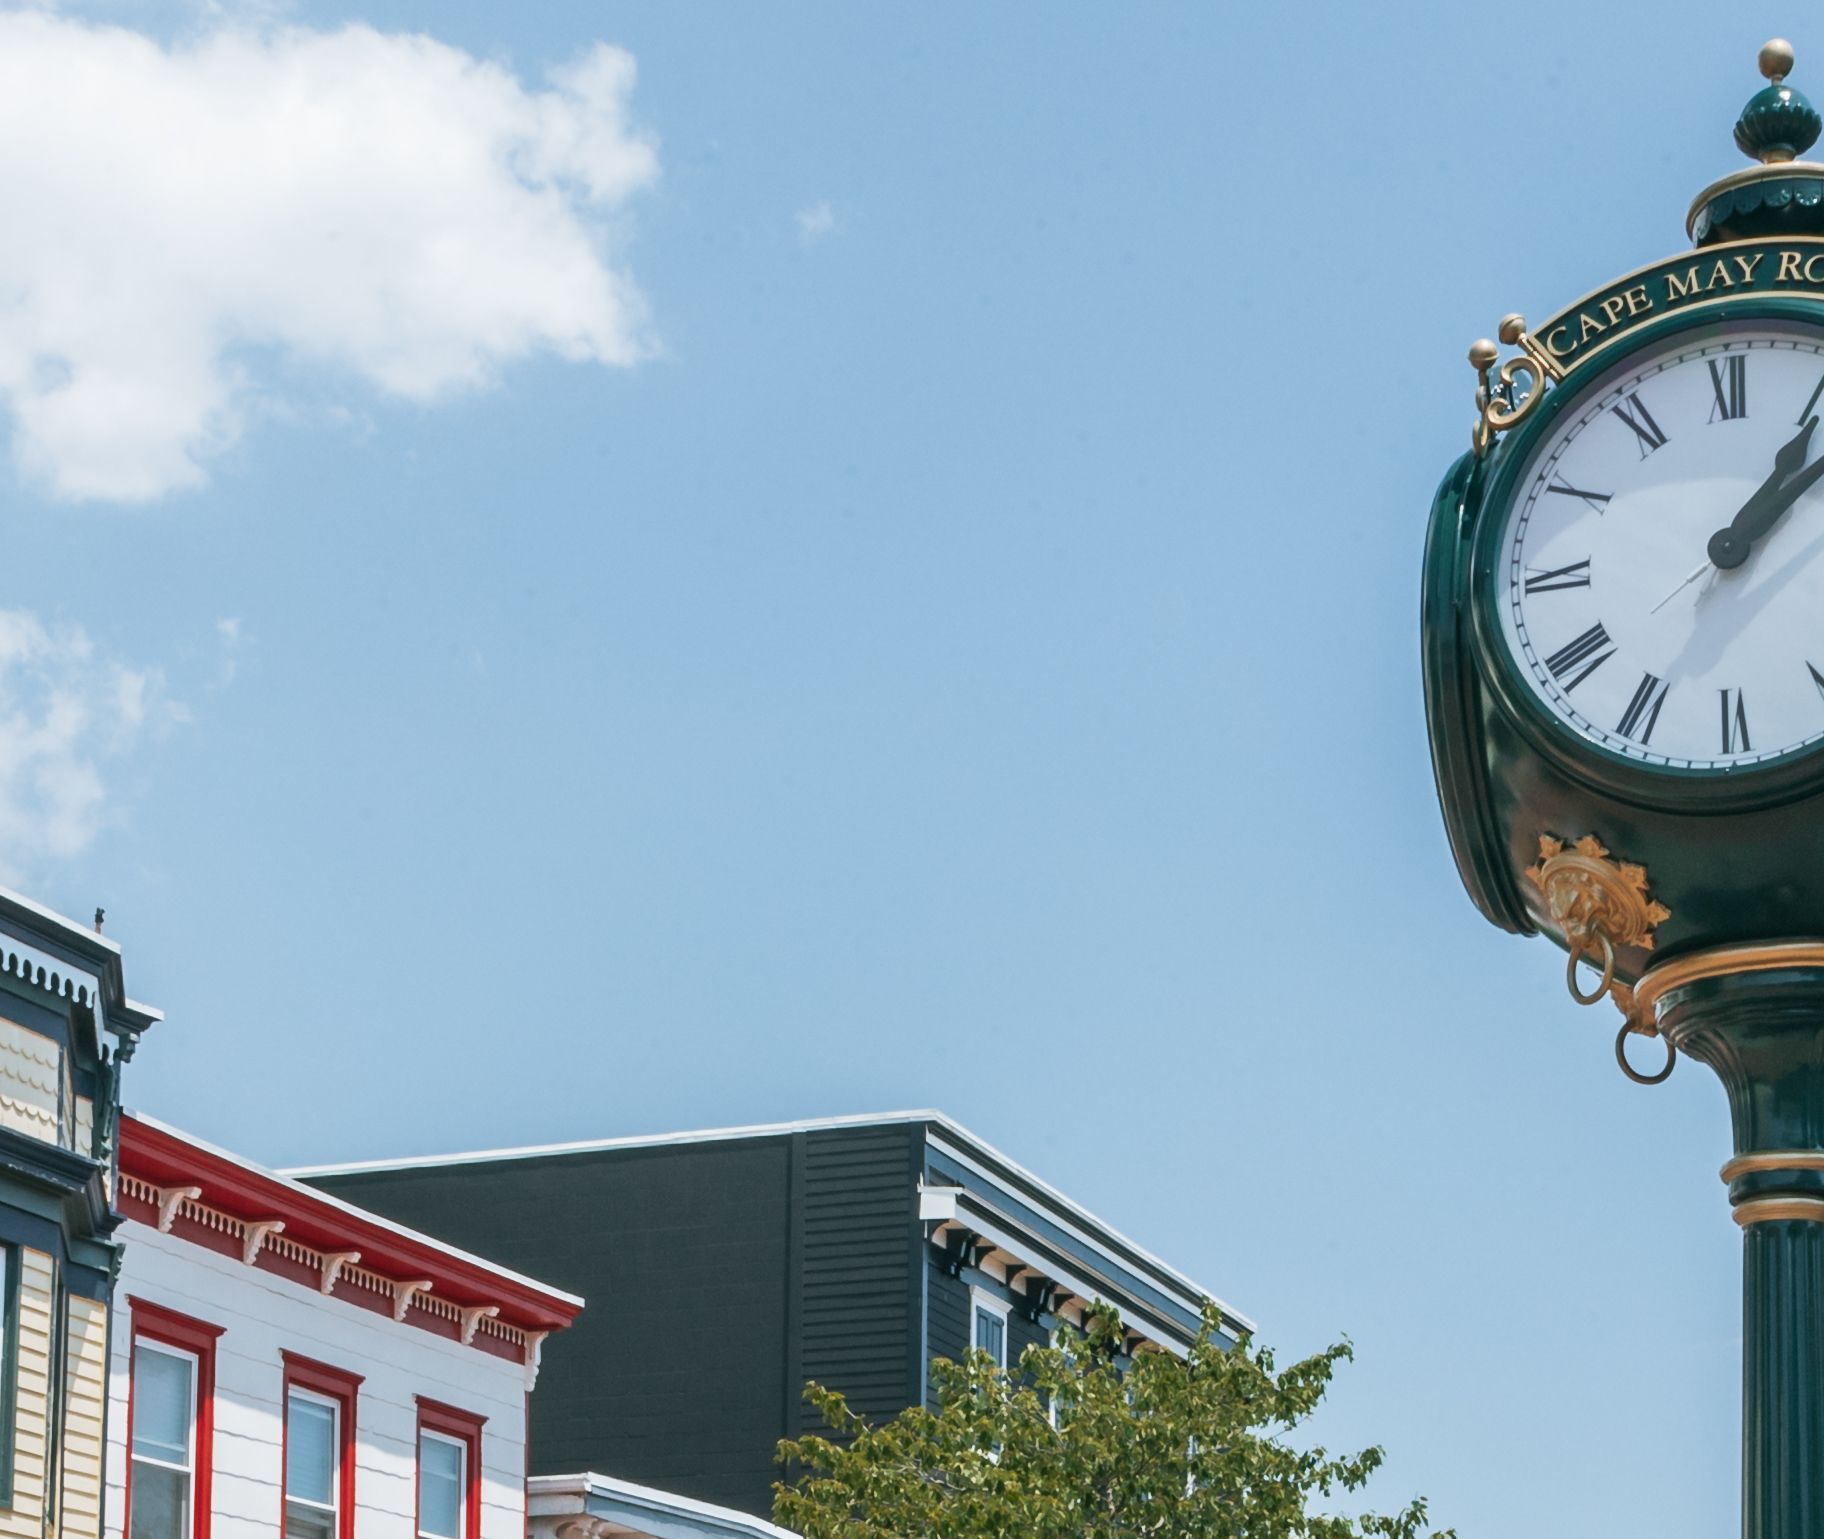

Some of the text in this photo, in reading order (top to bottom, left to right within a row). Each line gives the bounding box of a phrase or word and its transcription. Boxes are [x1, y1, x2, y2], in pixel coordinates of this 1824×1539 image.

[1546, 285, 1654, 357] CAPE
[1664, 253, 1764, 301] MAY
[1707, 354, 1749, 424] XII
[1608, 389, 1672, 461] XI
[1546, 470, 1614, 516] X
[1525, 554, 1591, 598] IX
[1542, 619, 1618, 696] VIII
[1612, 670, 1671, 747] VII
[1717, 686, 1755, 755] VI
